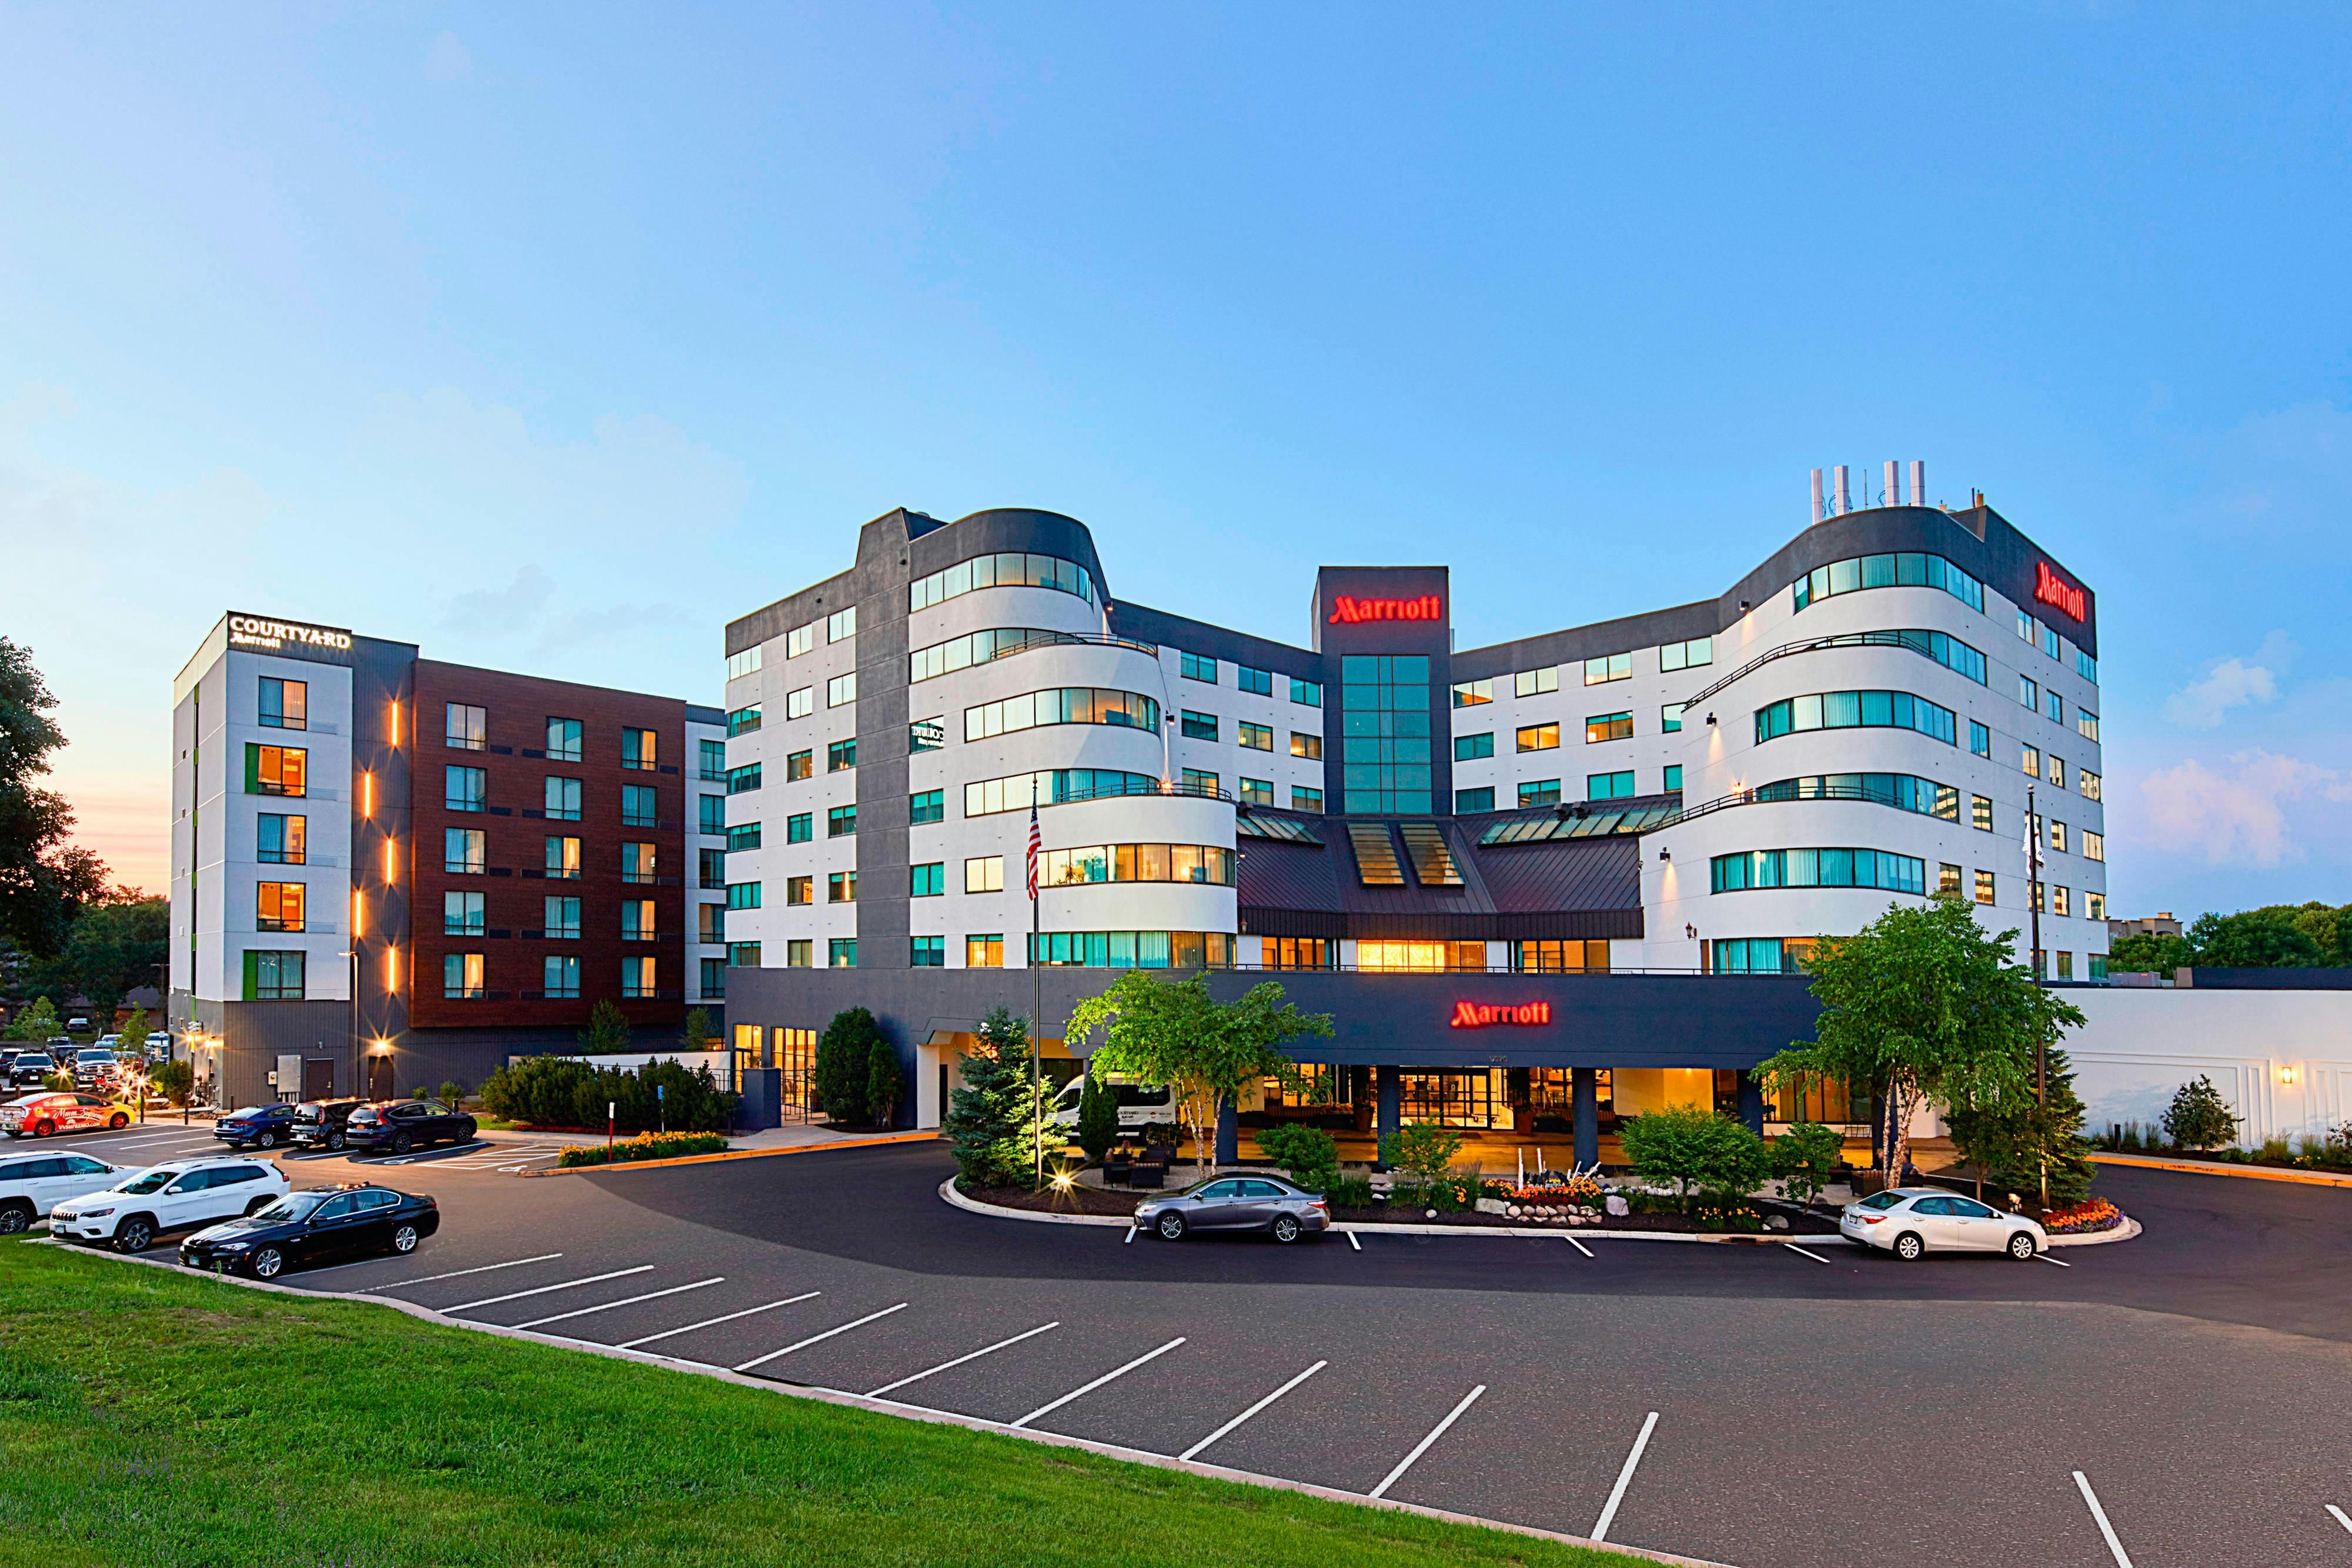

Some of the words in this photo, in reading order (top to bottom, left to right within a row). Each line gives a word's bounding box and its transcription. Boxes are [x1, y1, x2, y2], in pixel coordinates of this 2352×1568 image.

[2035, 561, 2085, 623] Marriott
[1328, 596, 1440, 623] Marriott
[230, 617, 351, 648] COURTYARD
[230, 632, 280, 648] Marriott
[1450, 1002, 1550, 1027] Marriott
